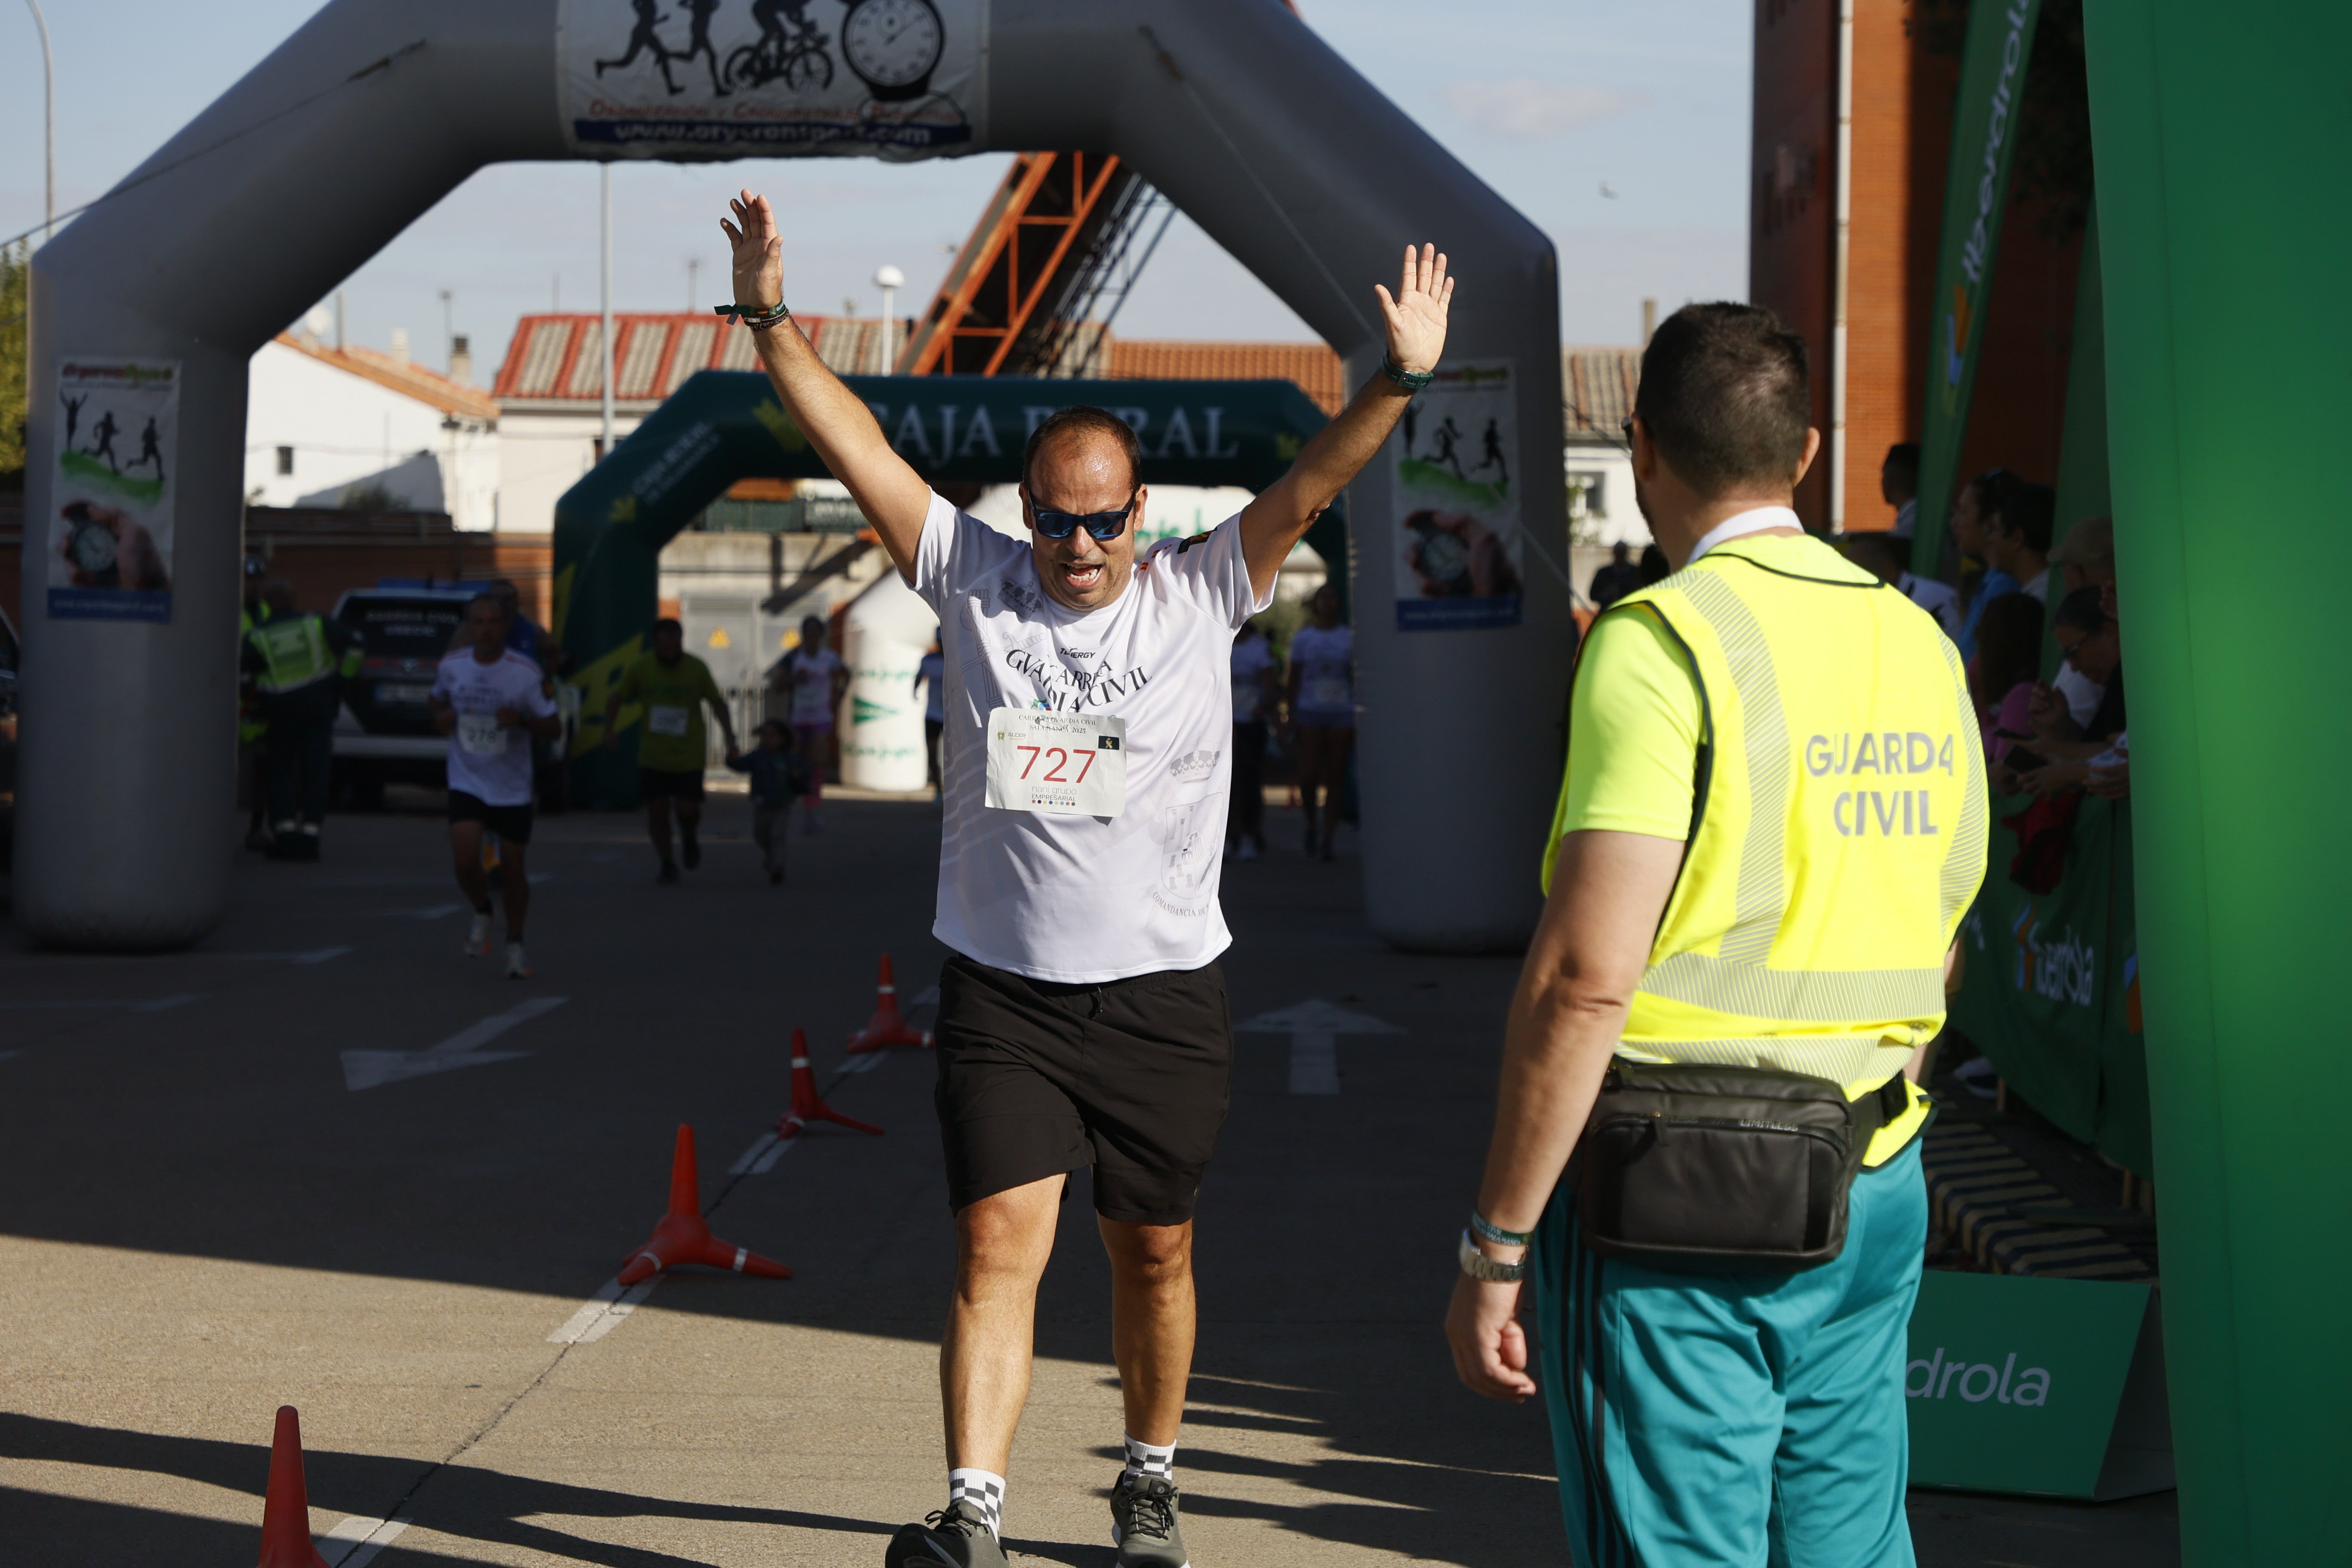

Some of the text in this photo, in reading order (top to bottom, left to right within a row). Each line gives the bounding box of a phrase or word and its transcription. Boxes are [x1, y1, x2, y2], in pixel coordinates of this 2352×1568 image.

[1962, 0, 2030, 283] Iberdrol
[867, 400, 1004, 470] AJA
[1087, 665, 1152, 707] CIVIL
[1017, 745, 1096, 784] 727
[1032, 793, 1076, 802] EMPRESARIAL
[1052, 787, 1077, 795] grupo
[1833, 790, 1939, 837] CIVIL
[1152, 891, 1196, 917] COMANDANCIA
[1740, 1118, 1799, 1132] LIMITLESS
